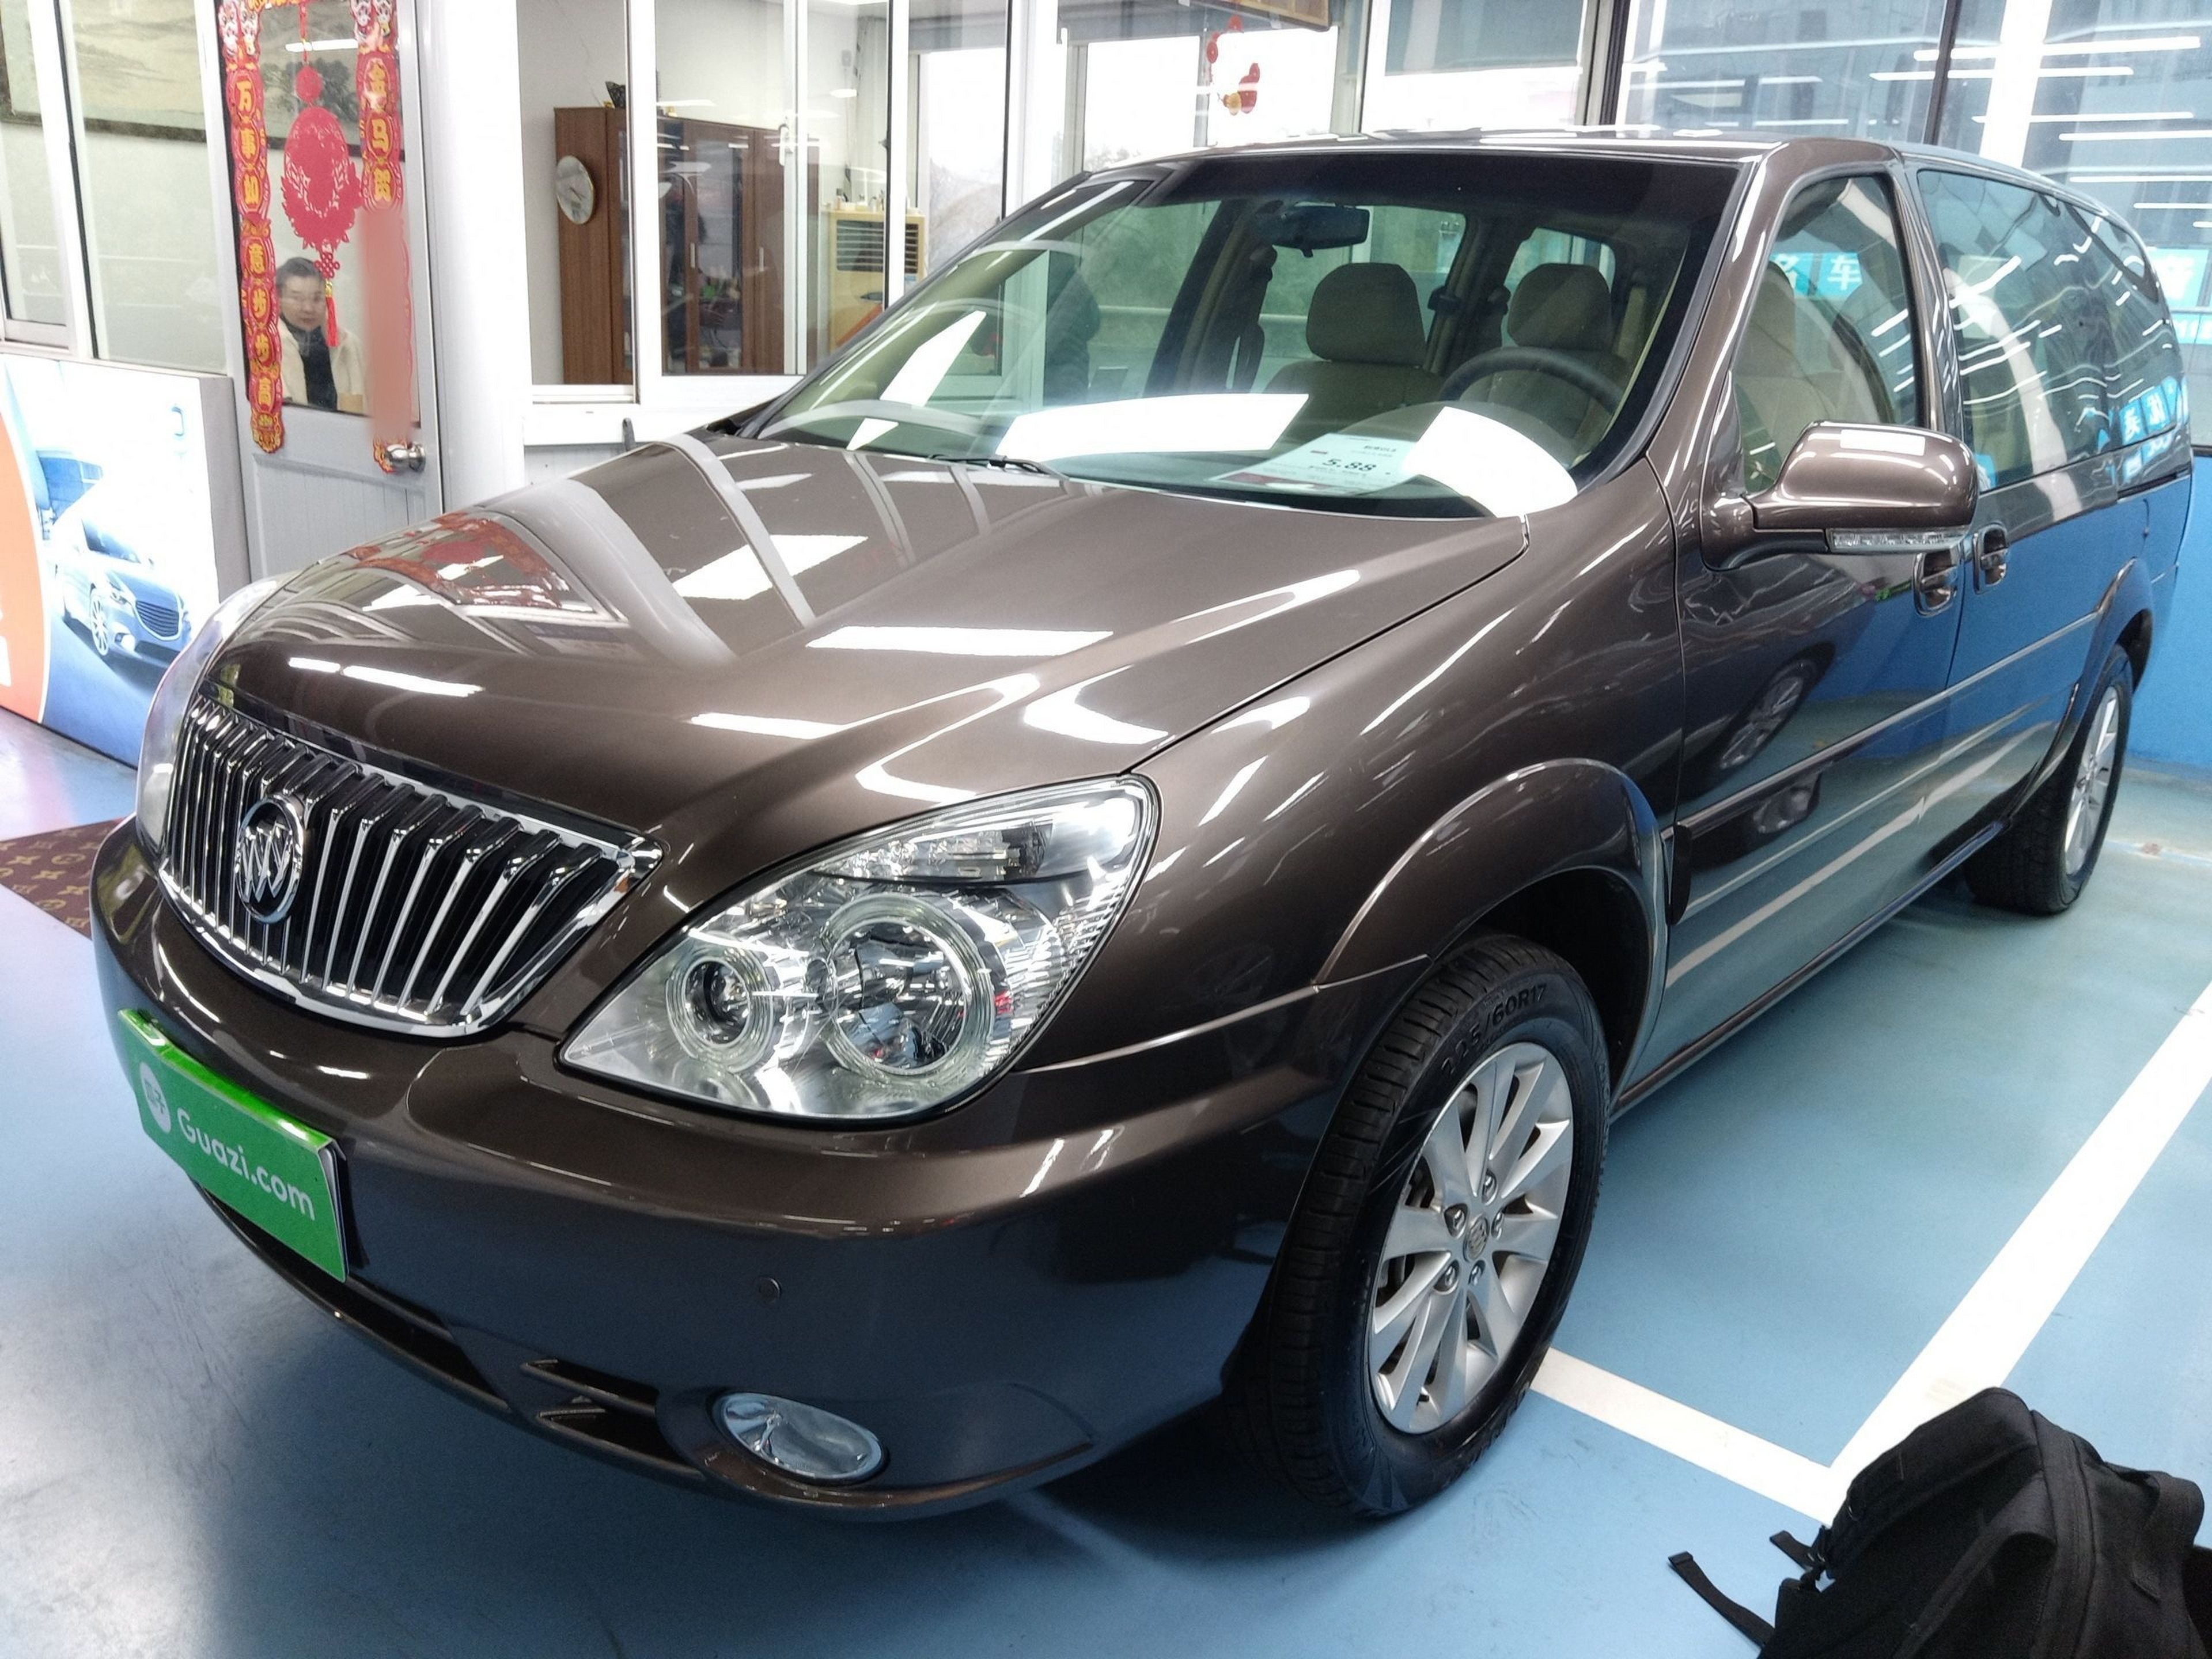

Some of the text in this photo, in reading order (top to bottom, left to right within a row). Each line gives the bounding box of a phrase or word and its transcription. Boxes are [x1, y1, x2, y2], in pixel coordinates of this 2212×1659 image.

[1322, 459, 1377, 471] 5.88
[1441, 983, 1547, 1075] 225/60R17
[177, 1108, 315, 1221] Guazi.com
